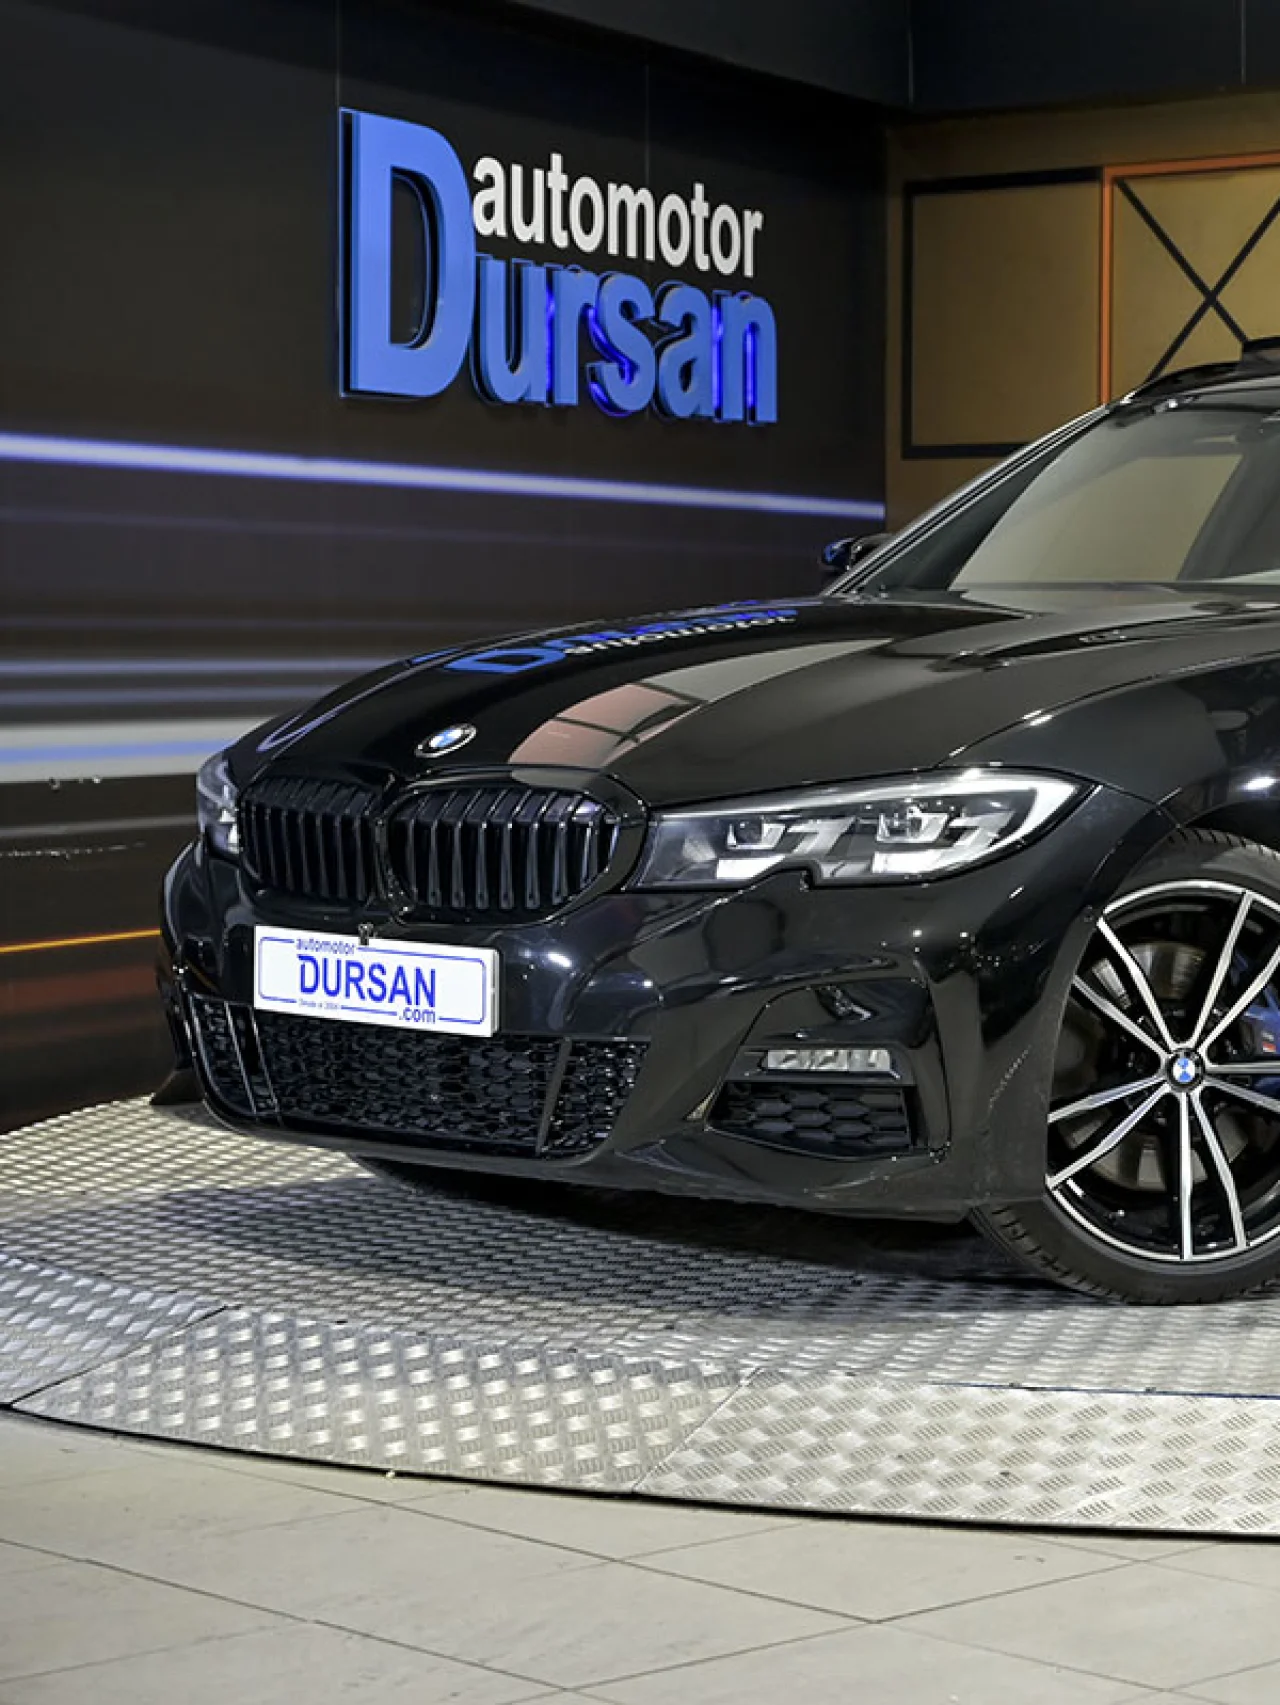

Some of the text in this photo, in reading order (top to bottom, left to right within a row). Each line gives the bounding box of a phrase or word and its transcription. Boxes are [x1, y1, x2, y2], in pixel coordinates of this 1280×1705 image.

[472, 153, 763, 278] automotor
[340, 107, 778, 425] Dursan
[296, 938, 354, 955] automotor
[297, 954, 436, 1008] DURSAN
[398, 1006, 436, 1024] .com
